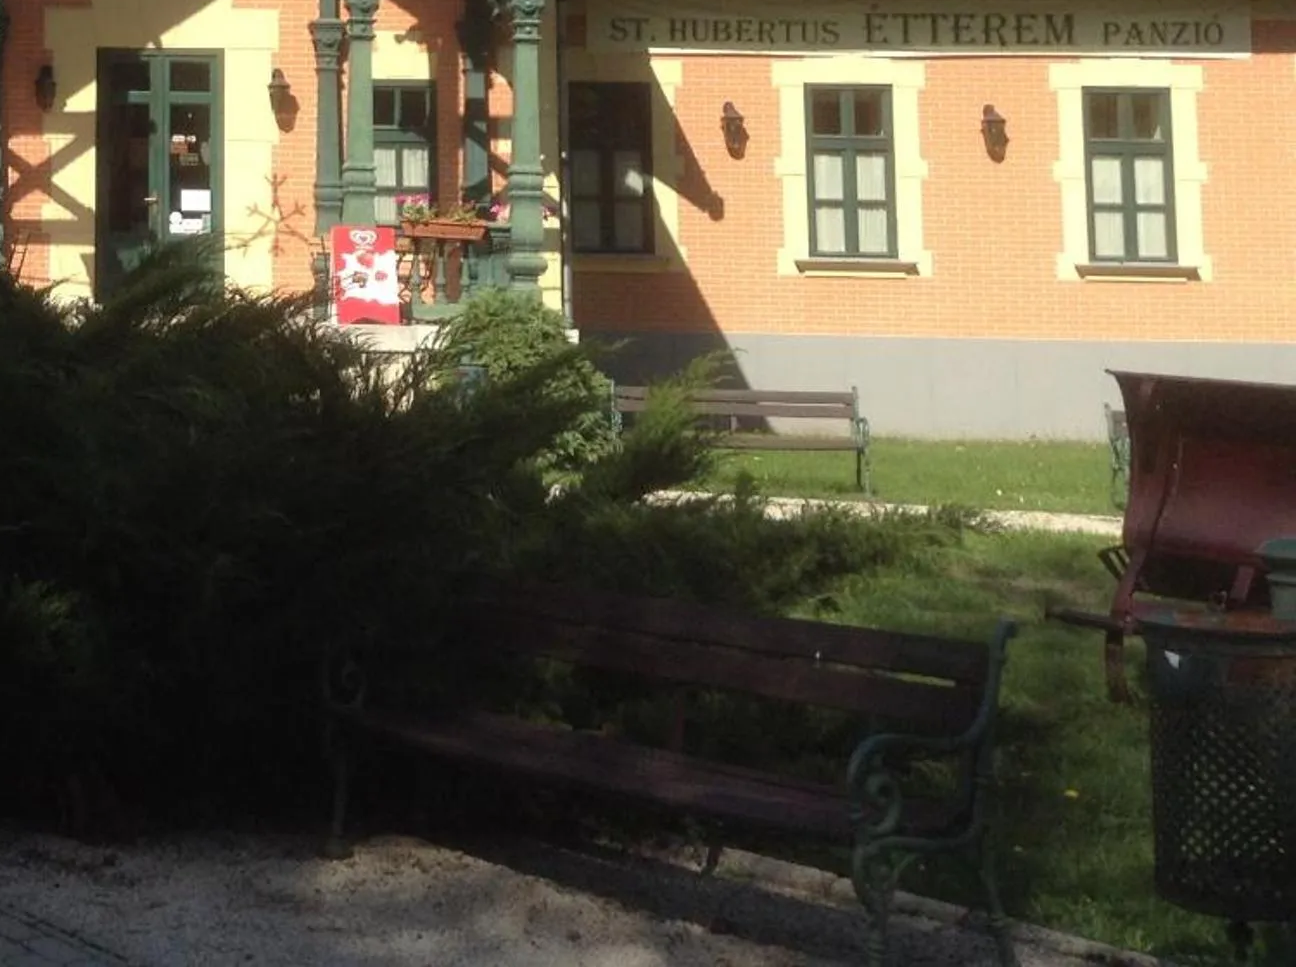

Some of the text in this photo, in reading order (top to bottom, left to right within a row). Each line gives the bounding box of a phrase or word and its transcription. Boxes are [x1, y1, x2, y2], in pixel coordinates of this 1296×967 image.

[609, 2, 1225, 46] ST. HUBERTUS ÉTTEREM PANZIÓ
